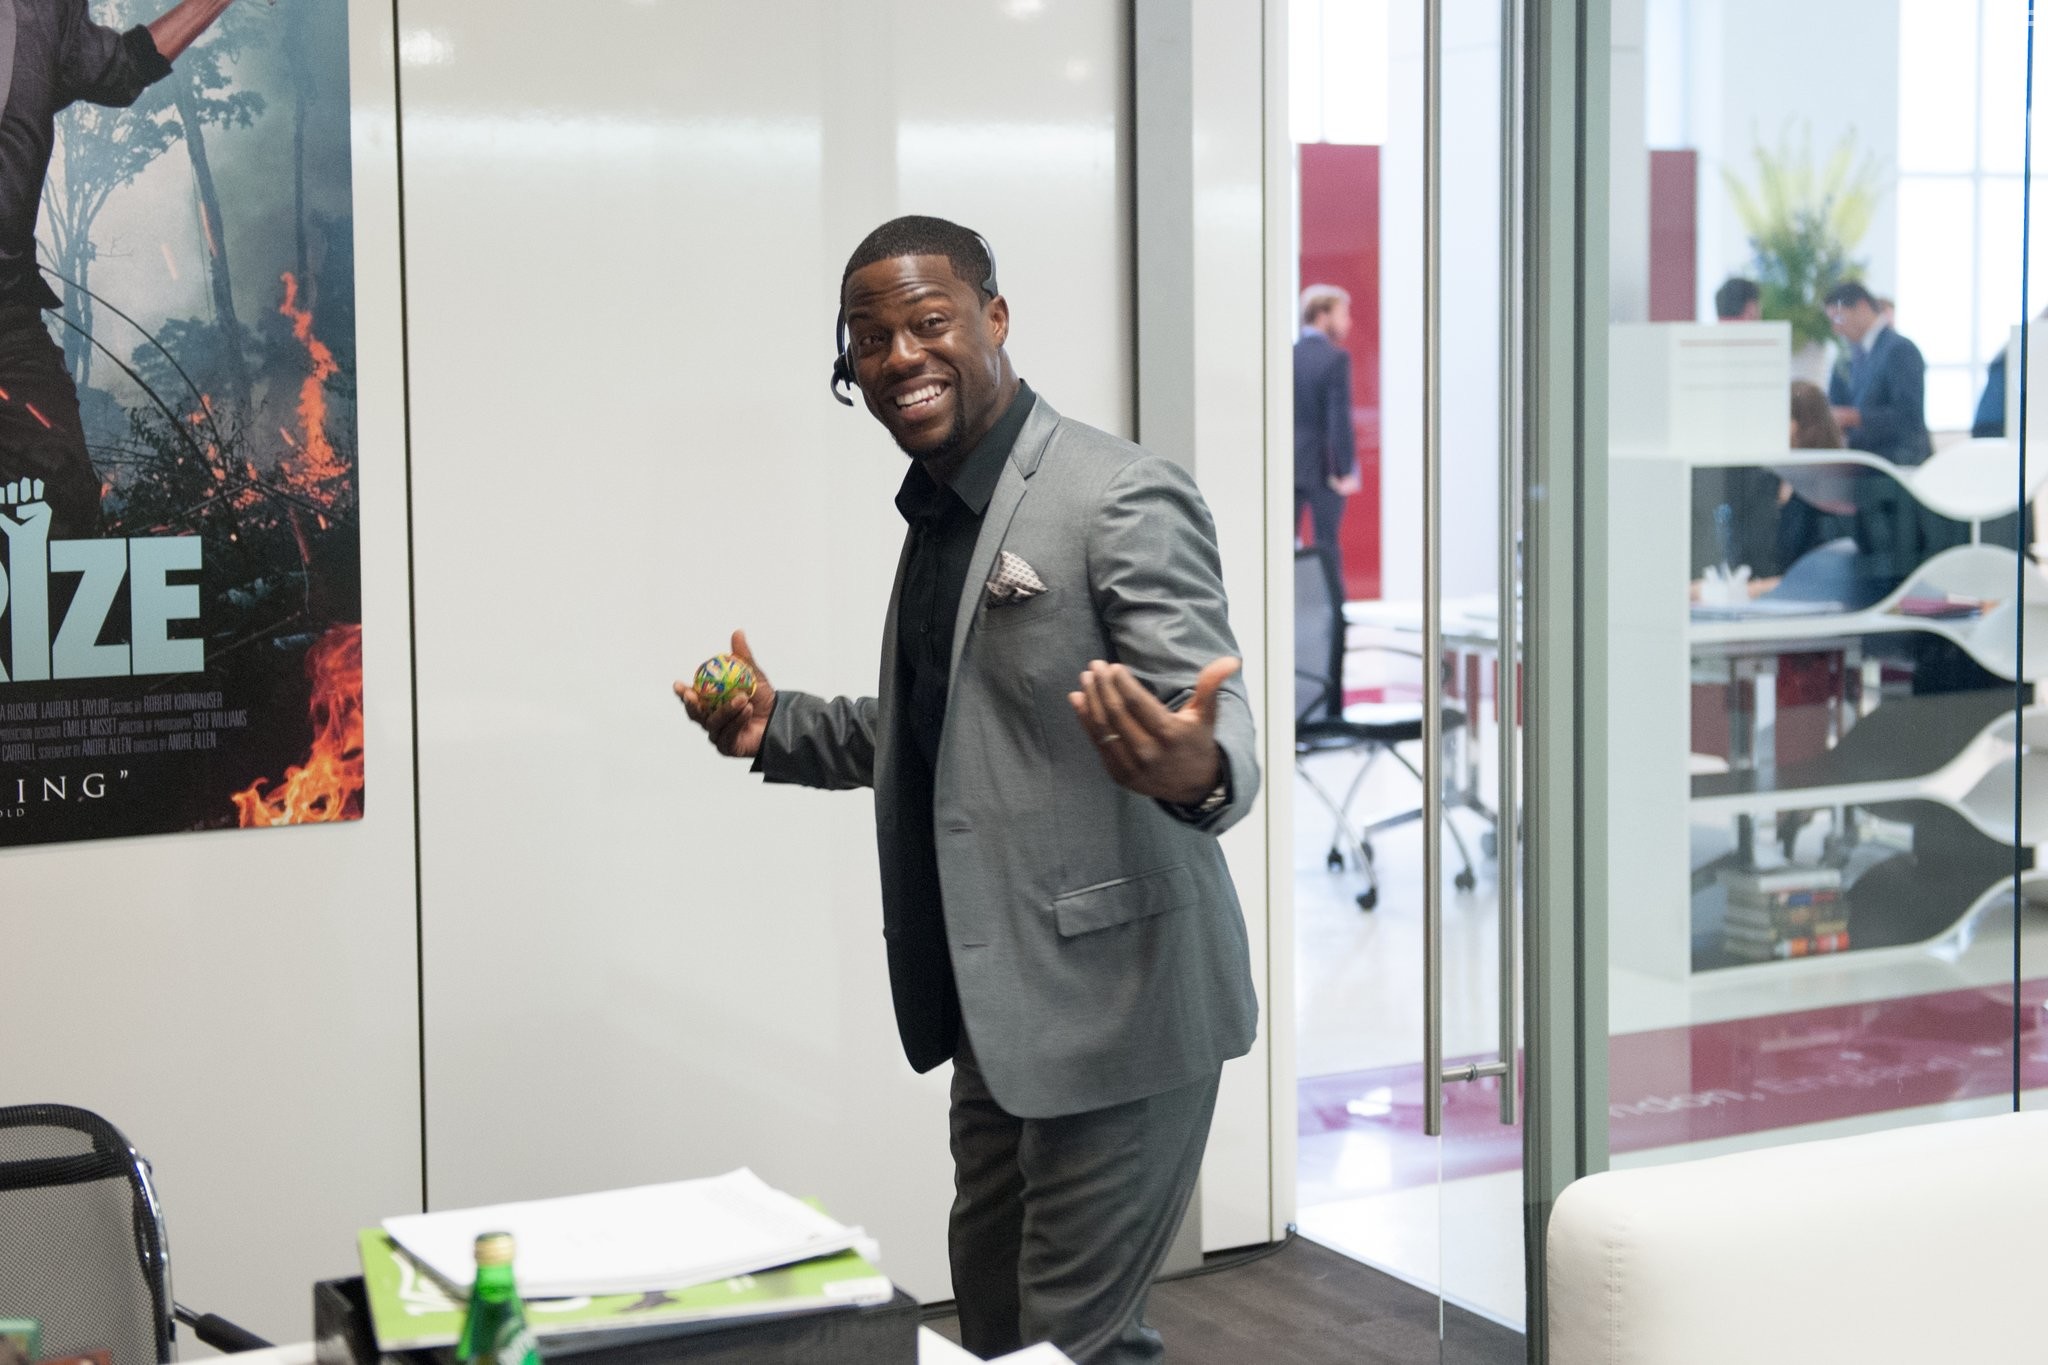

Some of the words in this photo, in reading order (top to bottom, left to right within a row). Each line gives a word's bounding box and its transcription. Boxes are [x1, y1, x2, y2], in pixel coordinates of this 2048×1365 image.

[0, 477, 204, 683] IZE
[41, 700, 71, 719] LAUREN
[81, 698, 110, 716] TAYLOR
[143, 694, 172, 712] ROBERT
[211, 709, 248, 728] WILLIAMS
[81, 738, 107, 756] ANDRE
[108, 736, 132, 755] ALLEN
[168, 732, 192, 750] ANDRE
[194, 731, 216, 749] ALLEN
